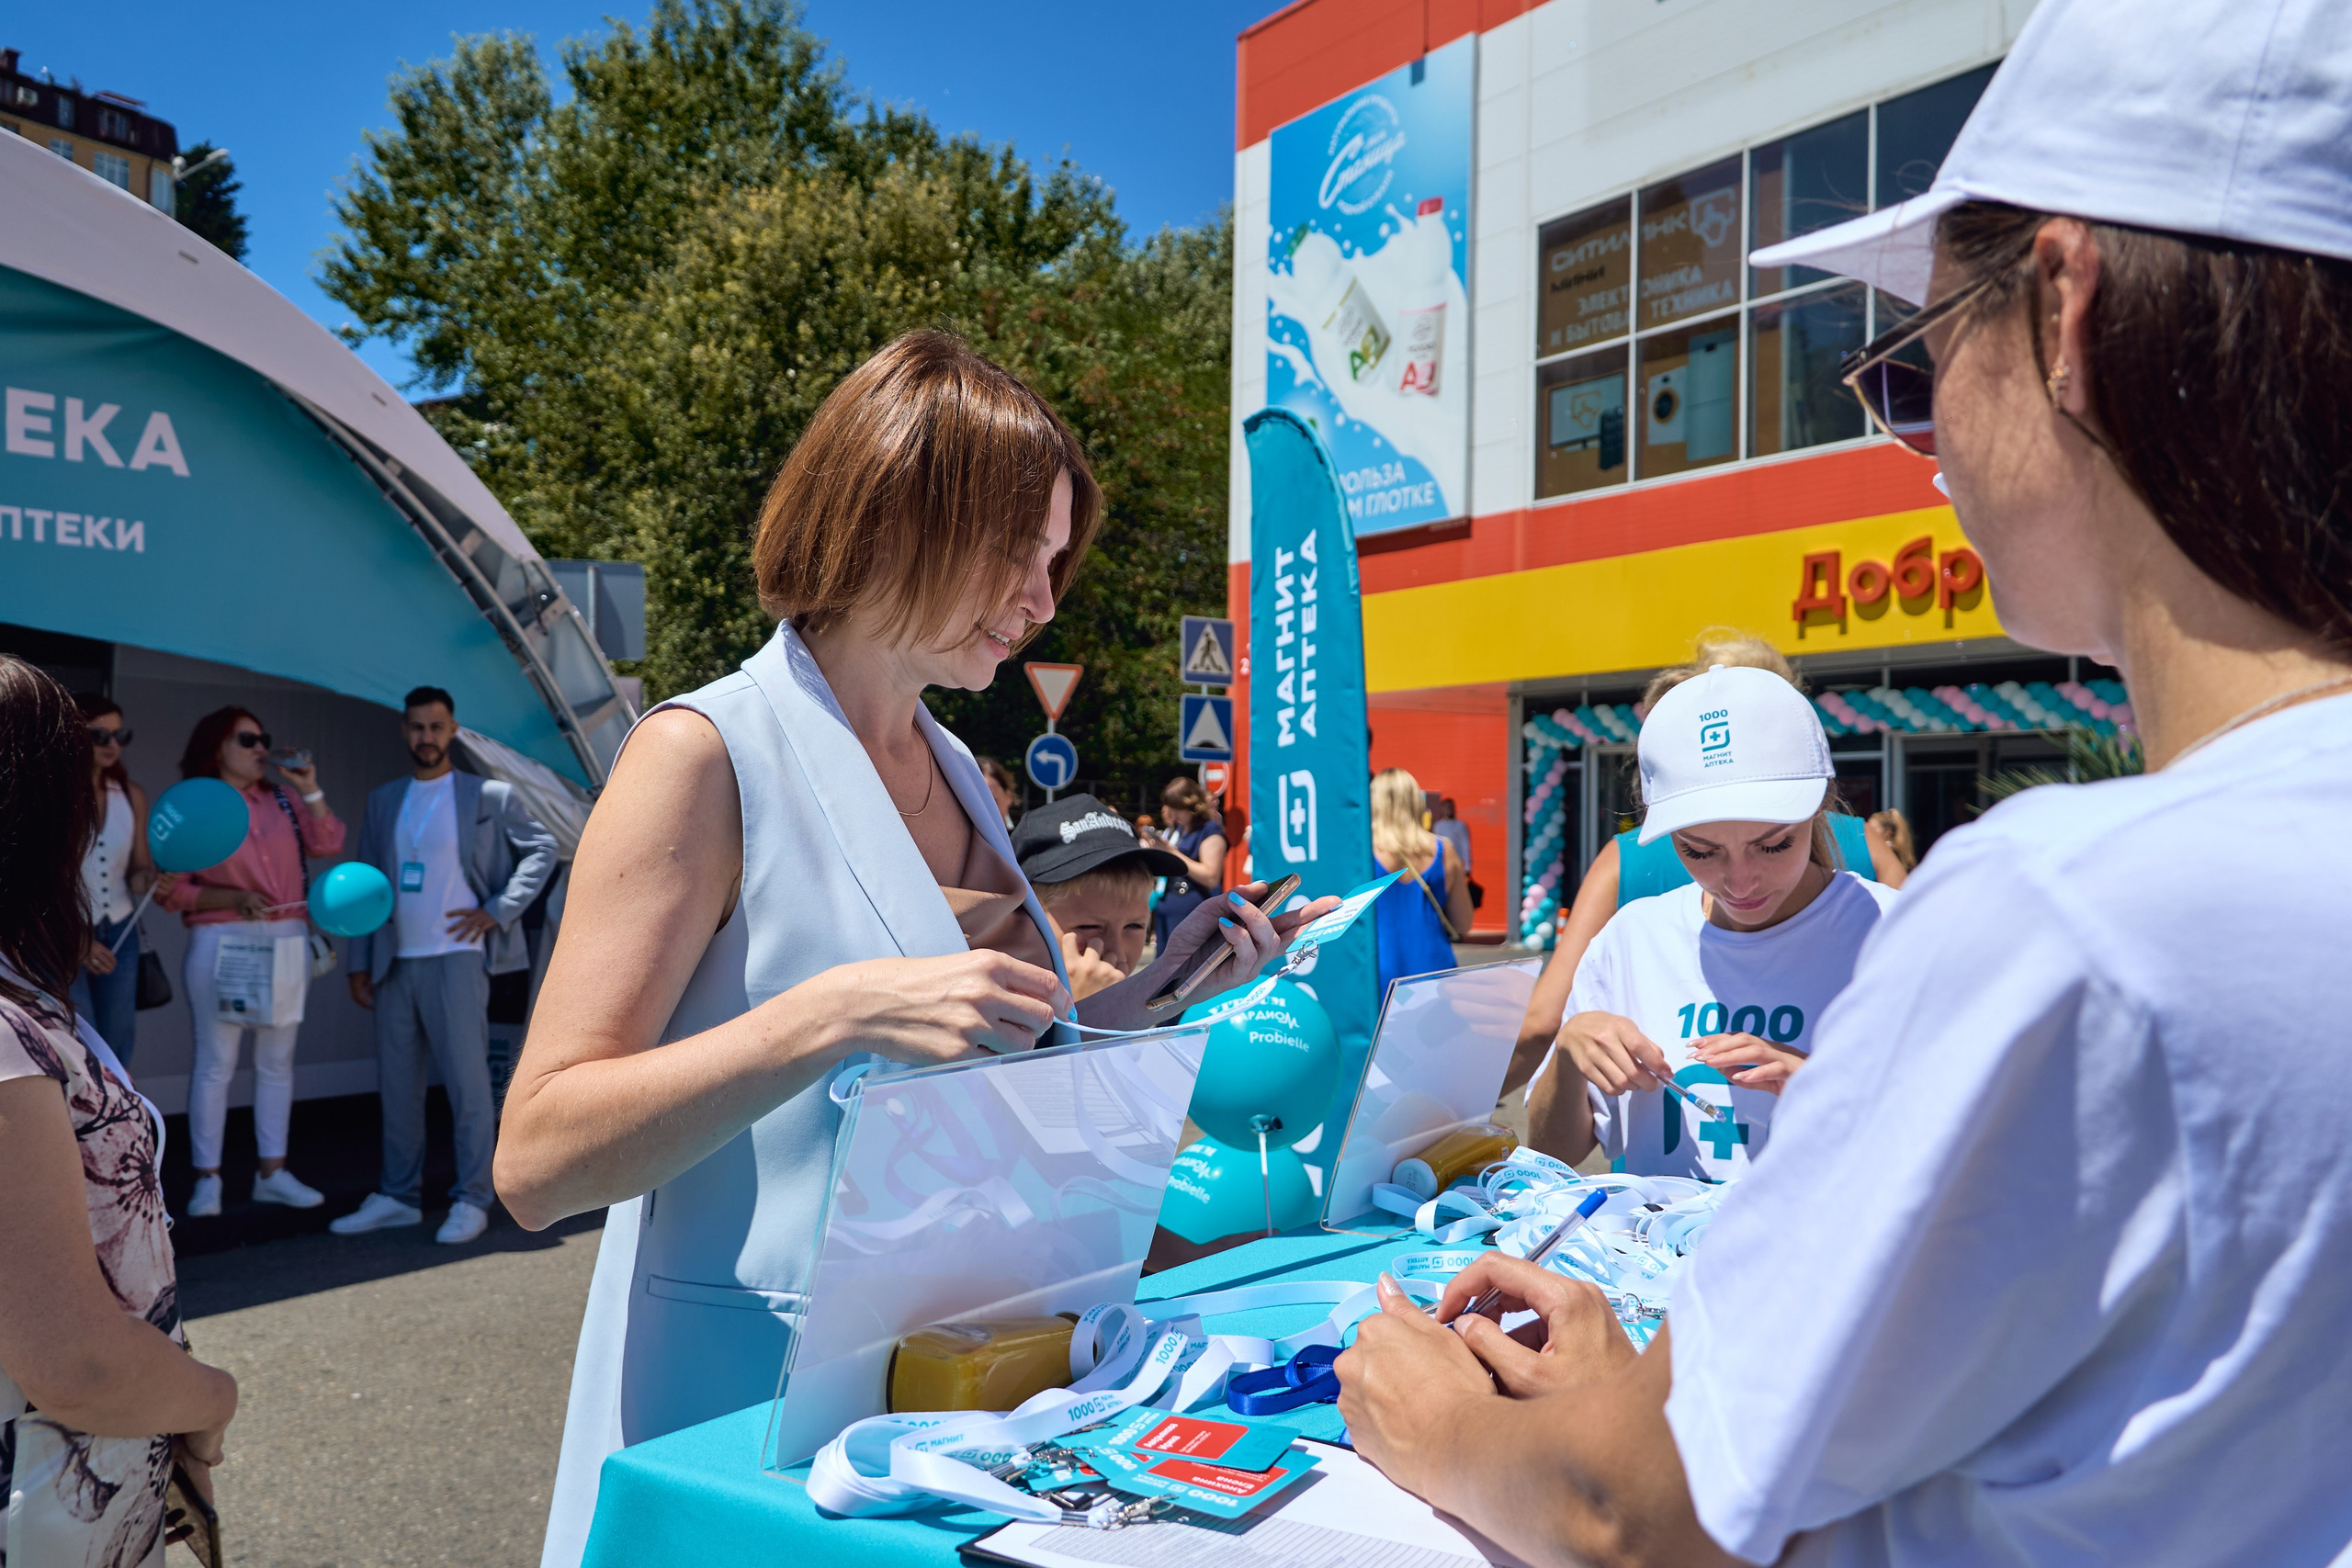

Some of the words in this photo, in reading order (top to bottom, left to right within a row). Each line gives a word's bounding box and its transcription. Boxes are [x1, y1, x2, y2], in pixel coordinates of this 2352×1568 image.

[1577, 265, 1703, 318] ЭЛЕКТОНИКА
[1566, 307, 1632, 344] БЫТОВА
[1339, 459, 1407, 495] ОЛЬЗА
[1365, 480, 1435, 517] ГЛОТКЕ
[1300, 527, 1318, 739] АПТЕКА
[1274, 547, 1296, 748] МАГНИТ
[1698, 708, 1729, 723] 1000
[1702, 750, 1733, 762] МАГНИТ
[1703, 758, 1735, 769] АПТЕКА
[1677, 1001, 1804, 1043] 1000
[1249, 1030, 1310, 1053] Probielle
[1516, 1169, 1542, 1180] 1000
[1155, 1336, 1178, 1365] 1000
[1068, 1401, 1096, 1422] 1000
[930, 1433, 965, 1448] МАГНИТ
[1192, 1475, 1249, 1495] Анохина
[1216, 1474, 1256, 1491] Елена
[1187, 1488, 1239, 1508] 1000
